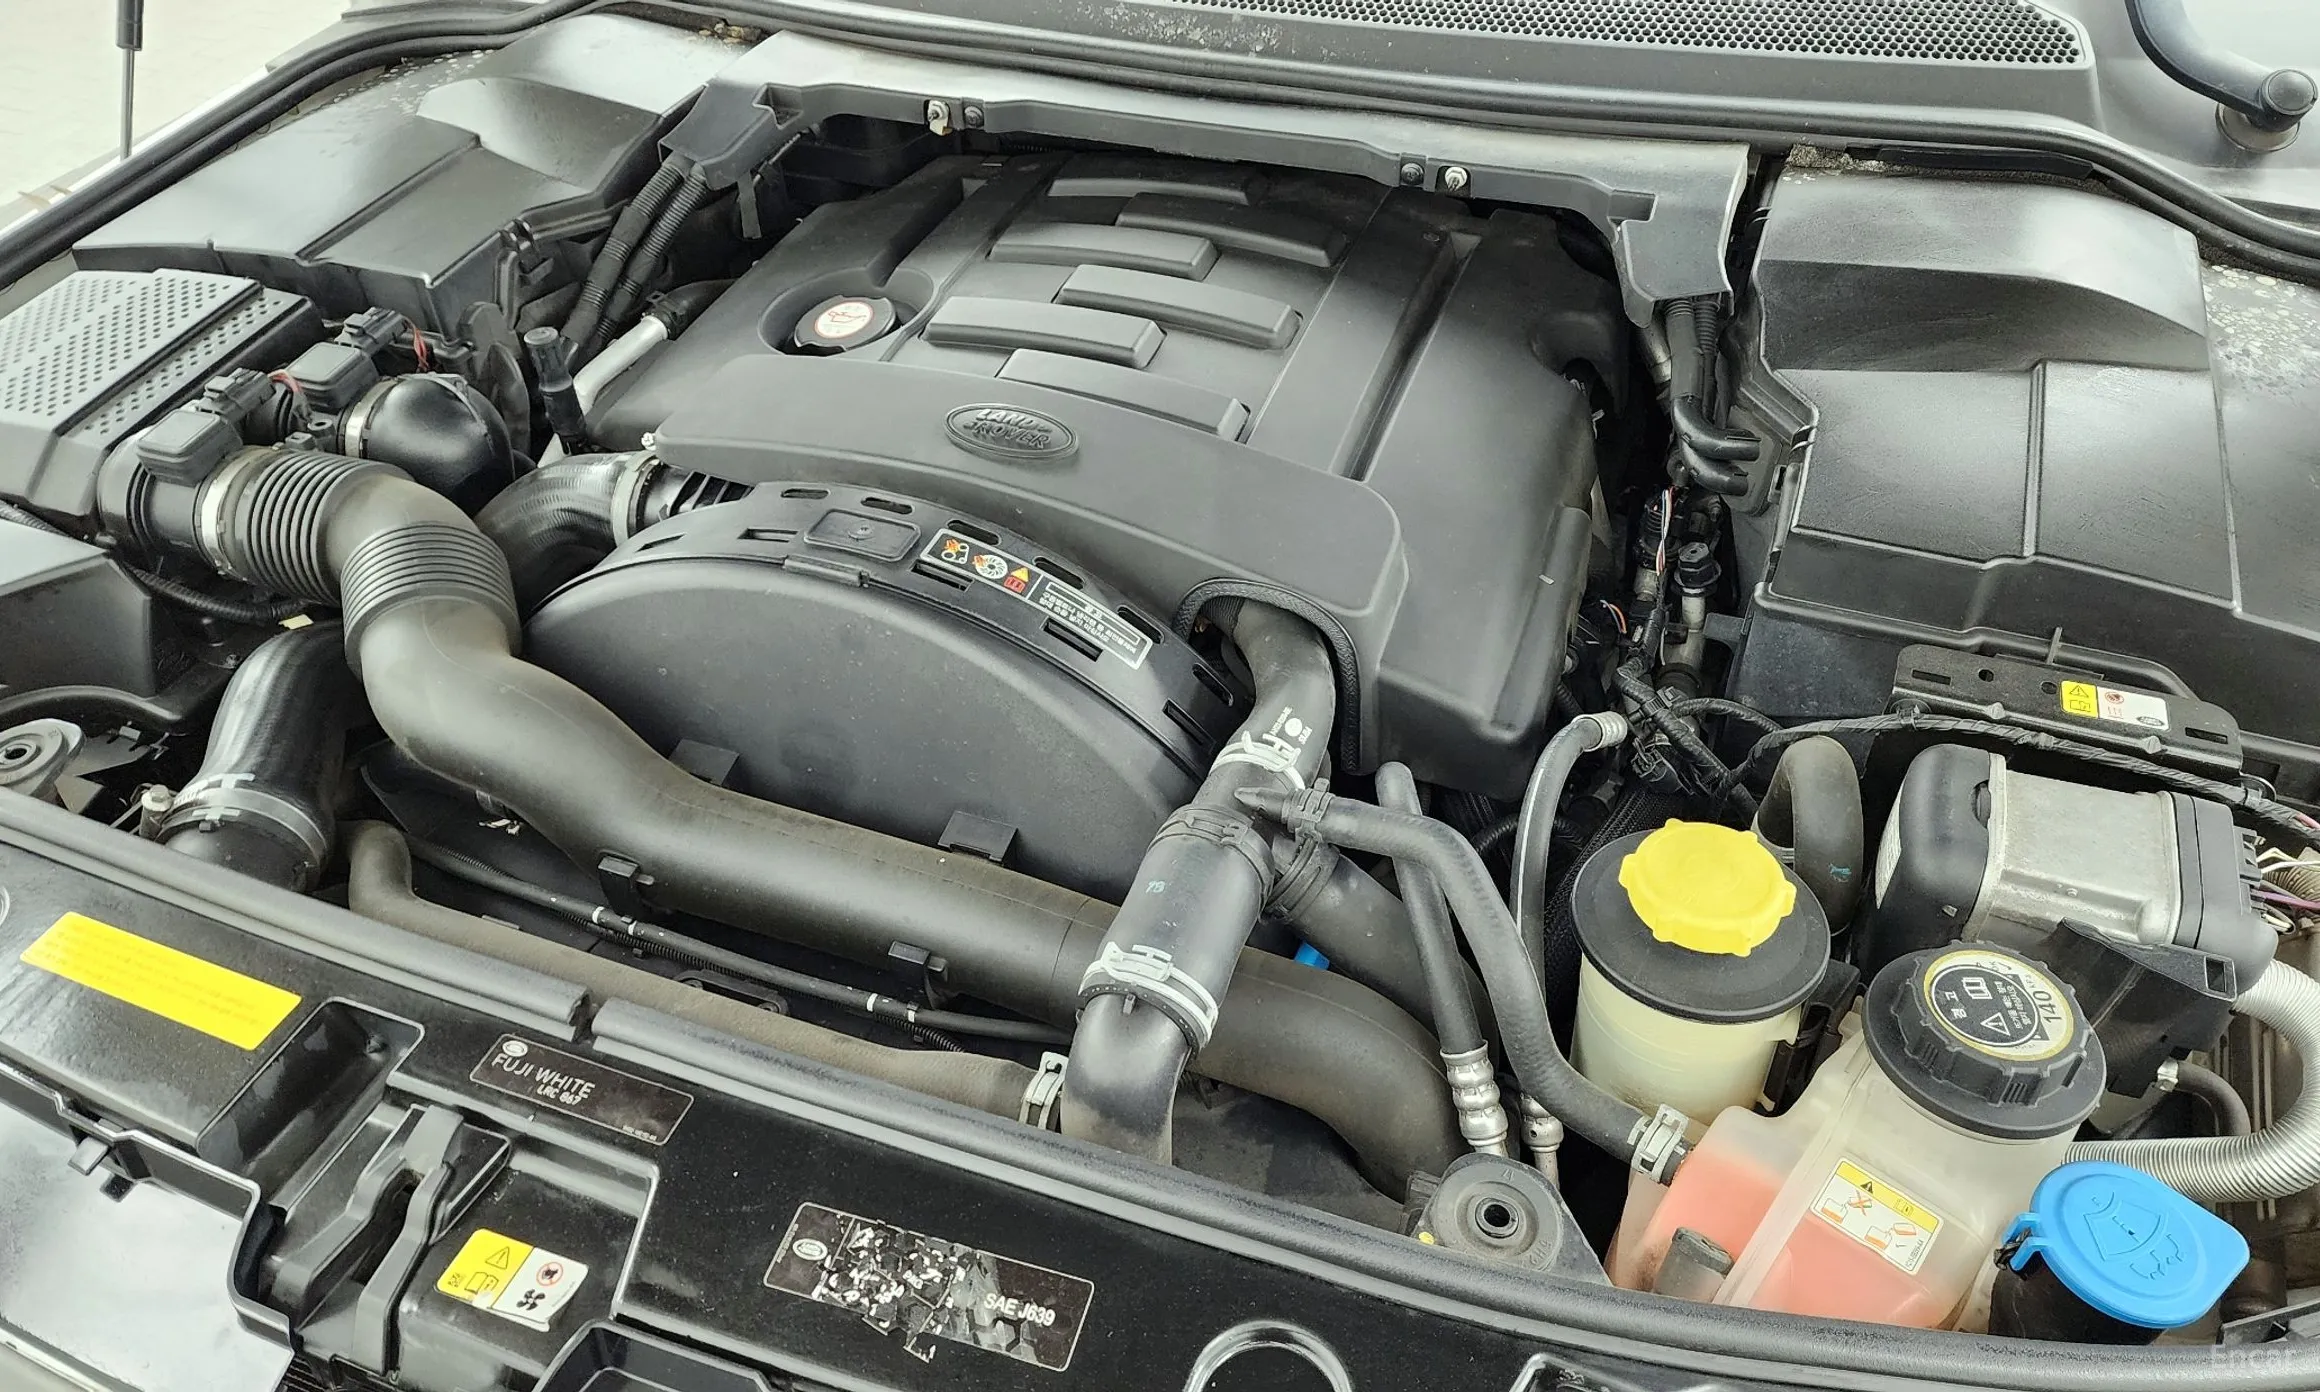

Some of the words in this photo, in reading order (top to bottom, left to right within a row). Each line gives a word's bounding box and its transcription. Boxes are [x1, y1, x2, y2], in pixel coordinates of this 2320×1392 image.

[976, 408, 1036, 430] LAND
[974, 422, 1050, 449] ROVER
[1944, 990, 1959, 1001] 고
[2032, 990, 2062, 1023] 140
[1950, 1008, 1968, 1019] 경
[491, 1052, 534, 1077] FUJI
[535, 1067, 595, 1099] WHITE
[537, 1084, 559, 1099] LRC
[559, 1091, 582, 1105] 867
[983, 1293, 1019, 1316] SAE
[1017, 1302, 1056, 1327] J639
